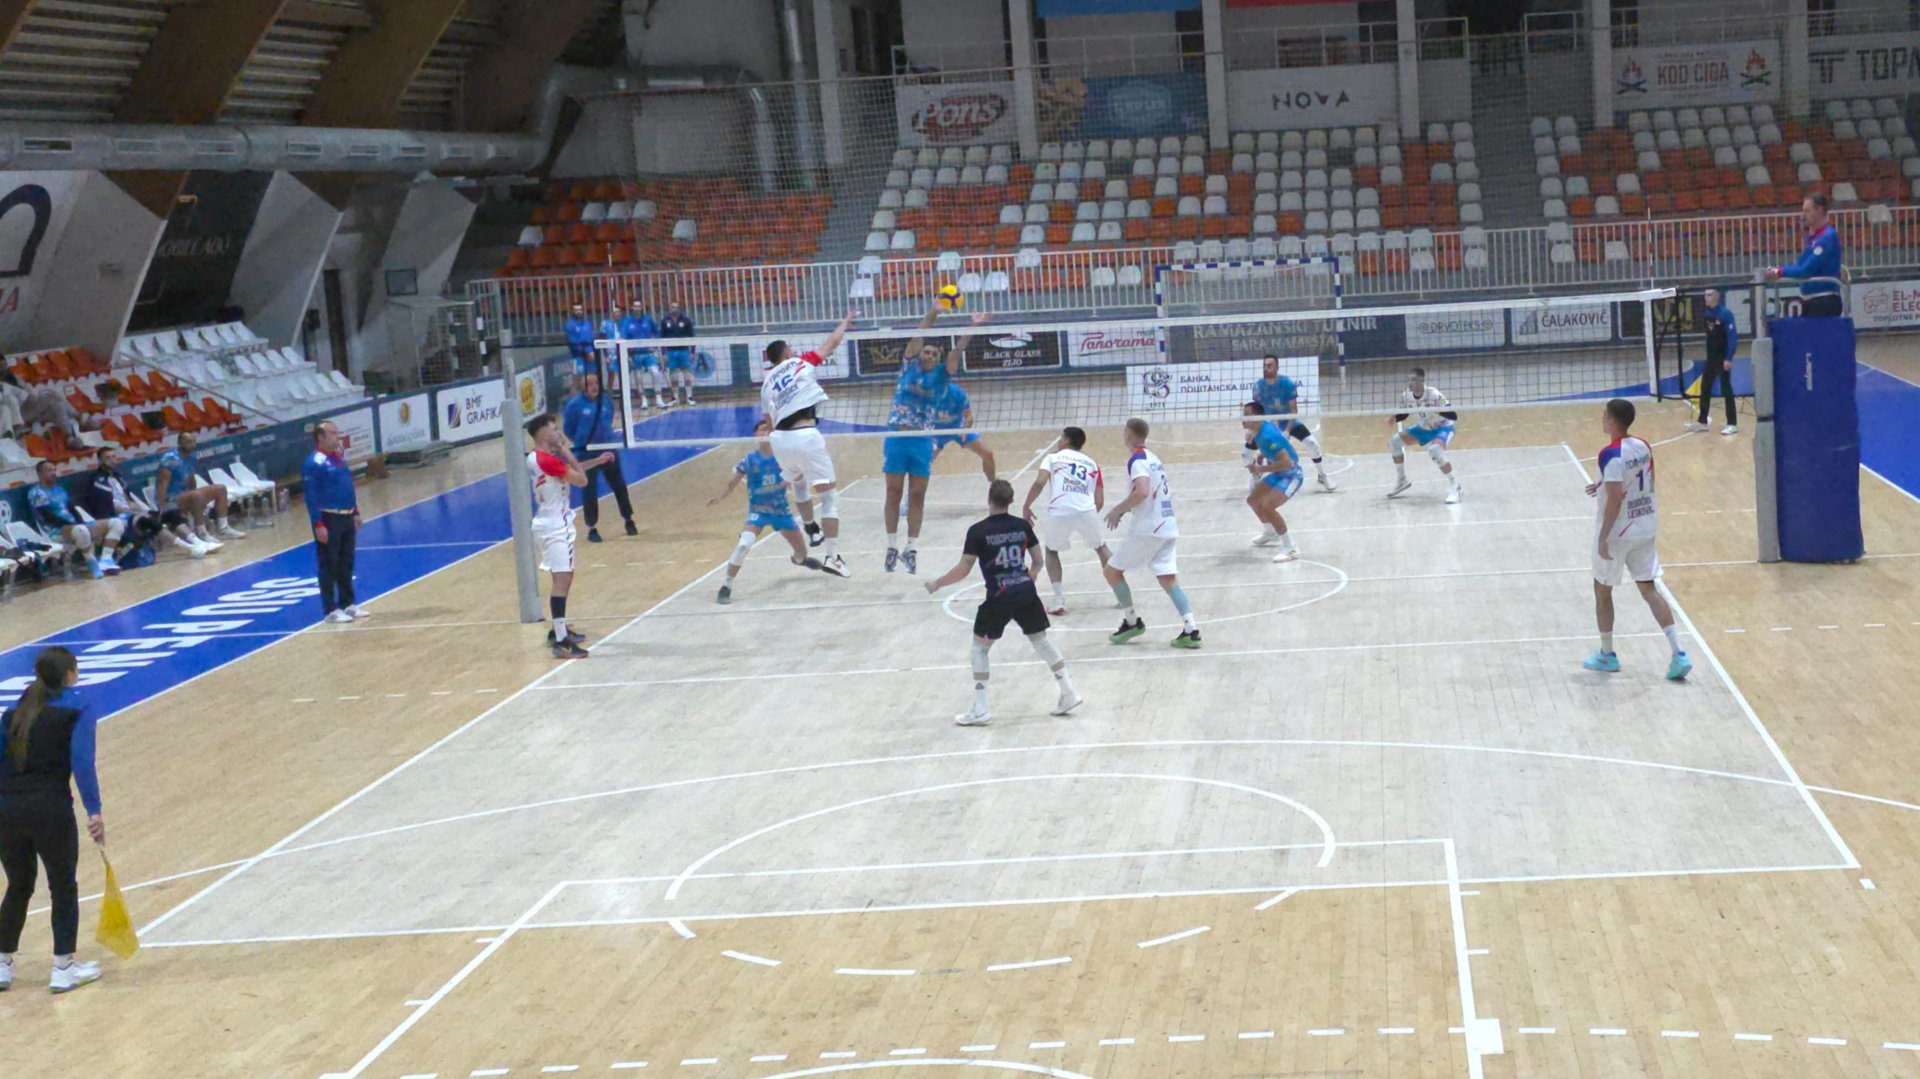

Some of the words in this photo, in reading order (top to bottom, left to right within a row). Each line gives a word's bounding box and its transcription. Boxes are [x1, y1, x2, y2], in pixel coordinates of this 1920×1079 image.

[1657, 64, 1689, 85] KOD
[914, 95, 1001, 131] Pons
[0, 286, 19, 314] A
[1541, 311, 1608, 328] ČALAKOVIĆ
[1193, 320, 1308, 339] RAMAZANSKI
[1079, 332, 1156, 352] Panorama
[1231, 339, 1266, 352] SARA
[983, 351, 1011, 361] BLACK
[773, 374, 794, 393] 16
[1180, 374, 1211, 384] БАНКА
[1180, 383, 1238, 394] ПОШТАНСКА
[465, 394, 483, 411] BMF
[762, 473, 777, 486] 20
[1068, 462, 1088, 481] 13
[1636, 469, 1644, 492] 1
[1160, 474, 1169, 495] 3
[995, 544, 1021, 569] 49
